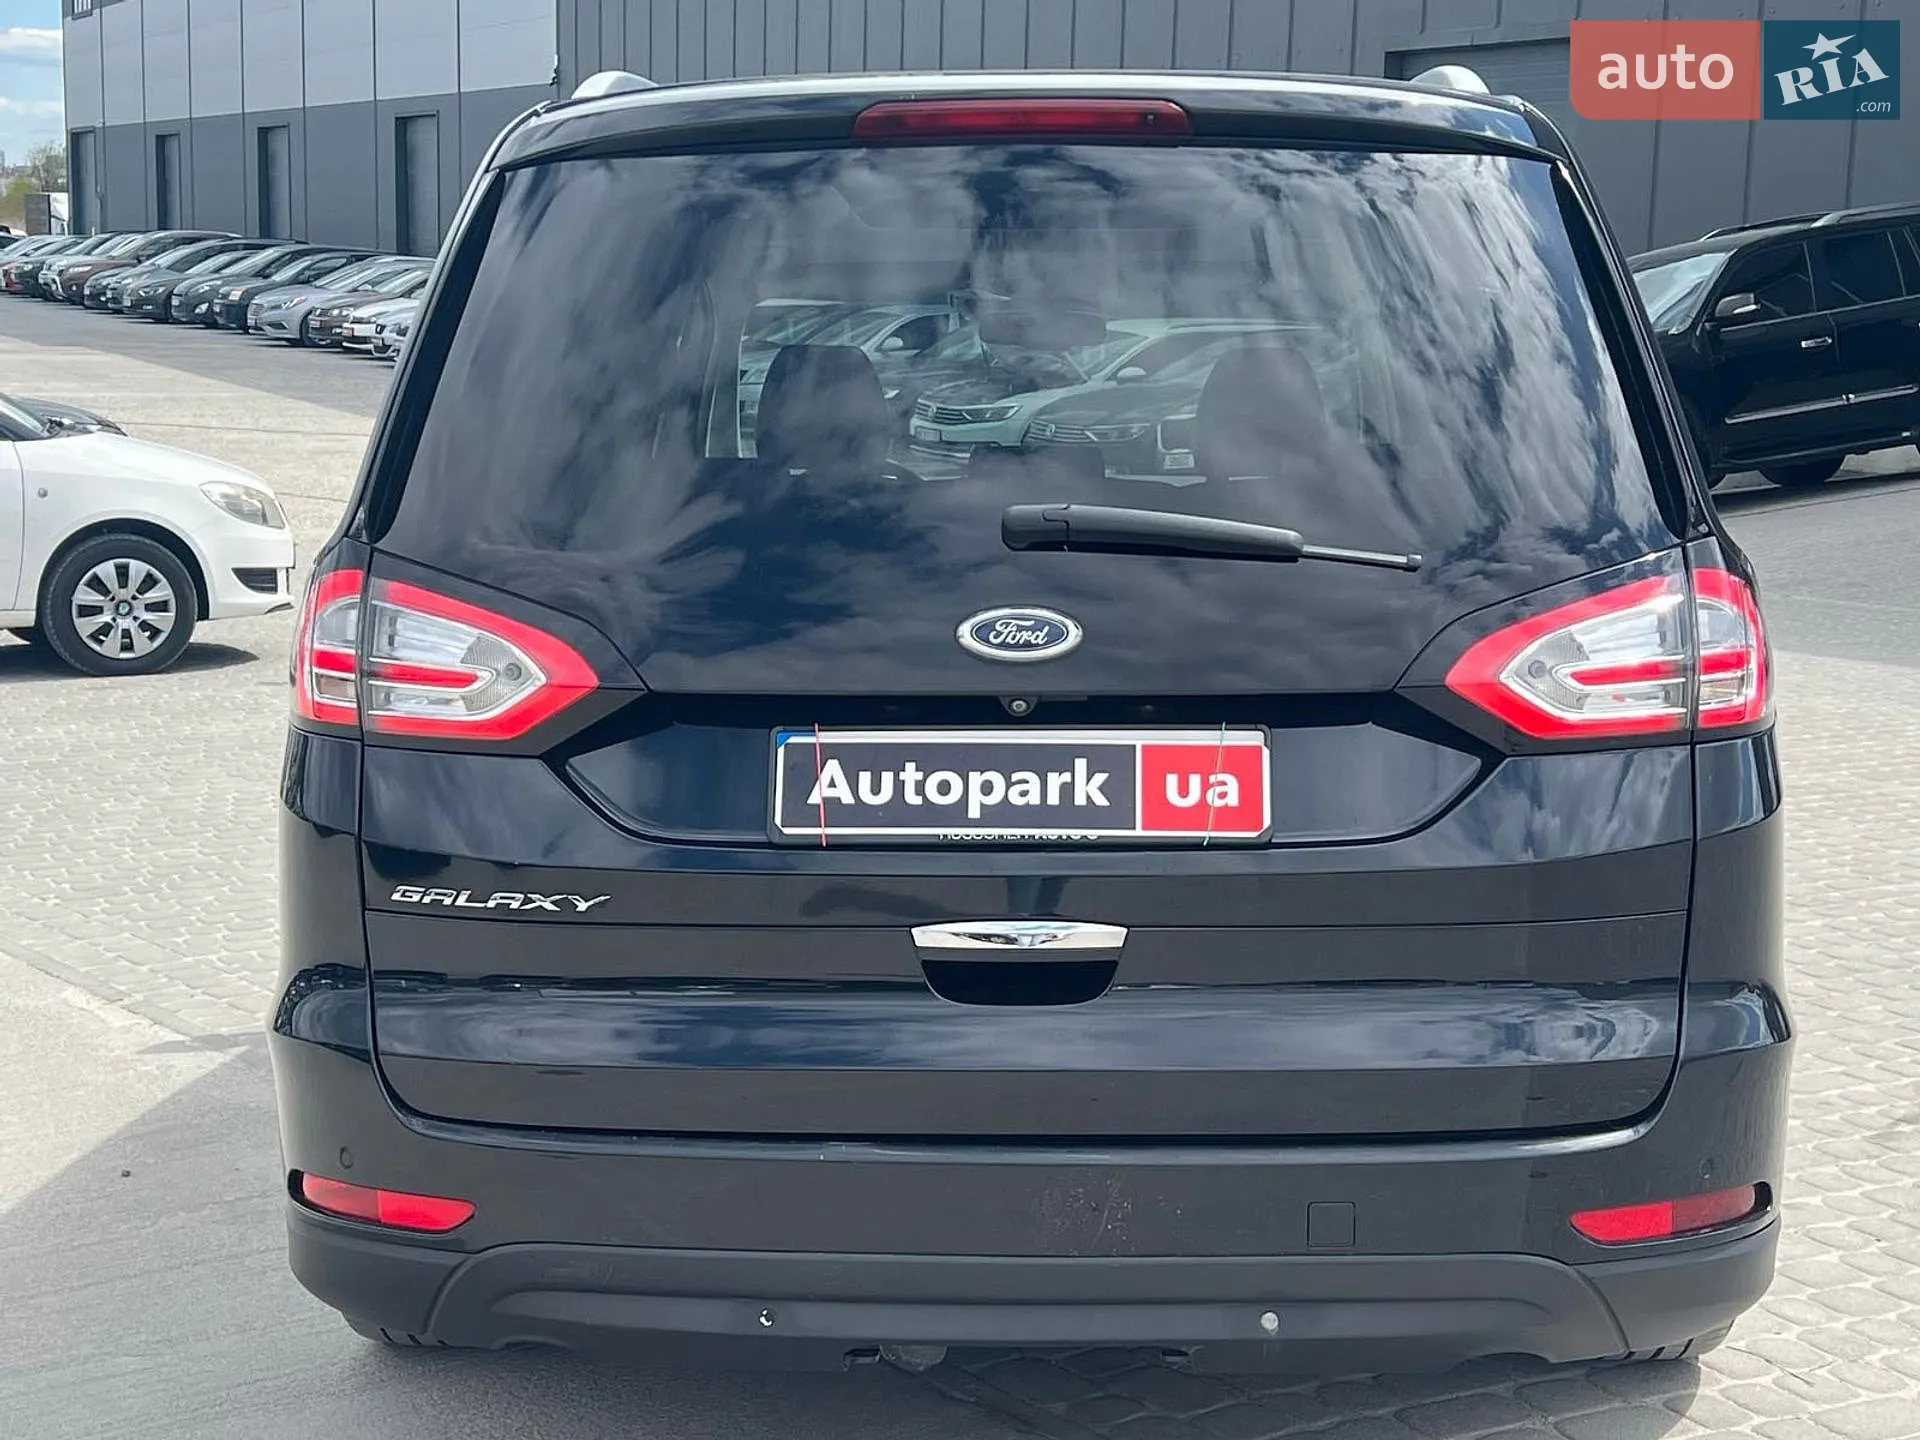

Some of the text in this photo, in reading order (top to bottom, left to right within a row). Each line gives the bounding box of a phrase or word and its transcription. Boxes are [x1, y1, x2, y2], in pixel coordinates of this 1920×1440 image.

[988, 619, 1050, 645] Ford
[806, 757, 1241, 819] Autopark ua
[390, 885, 612, 912] GALAXY
